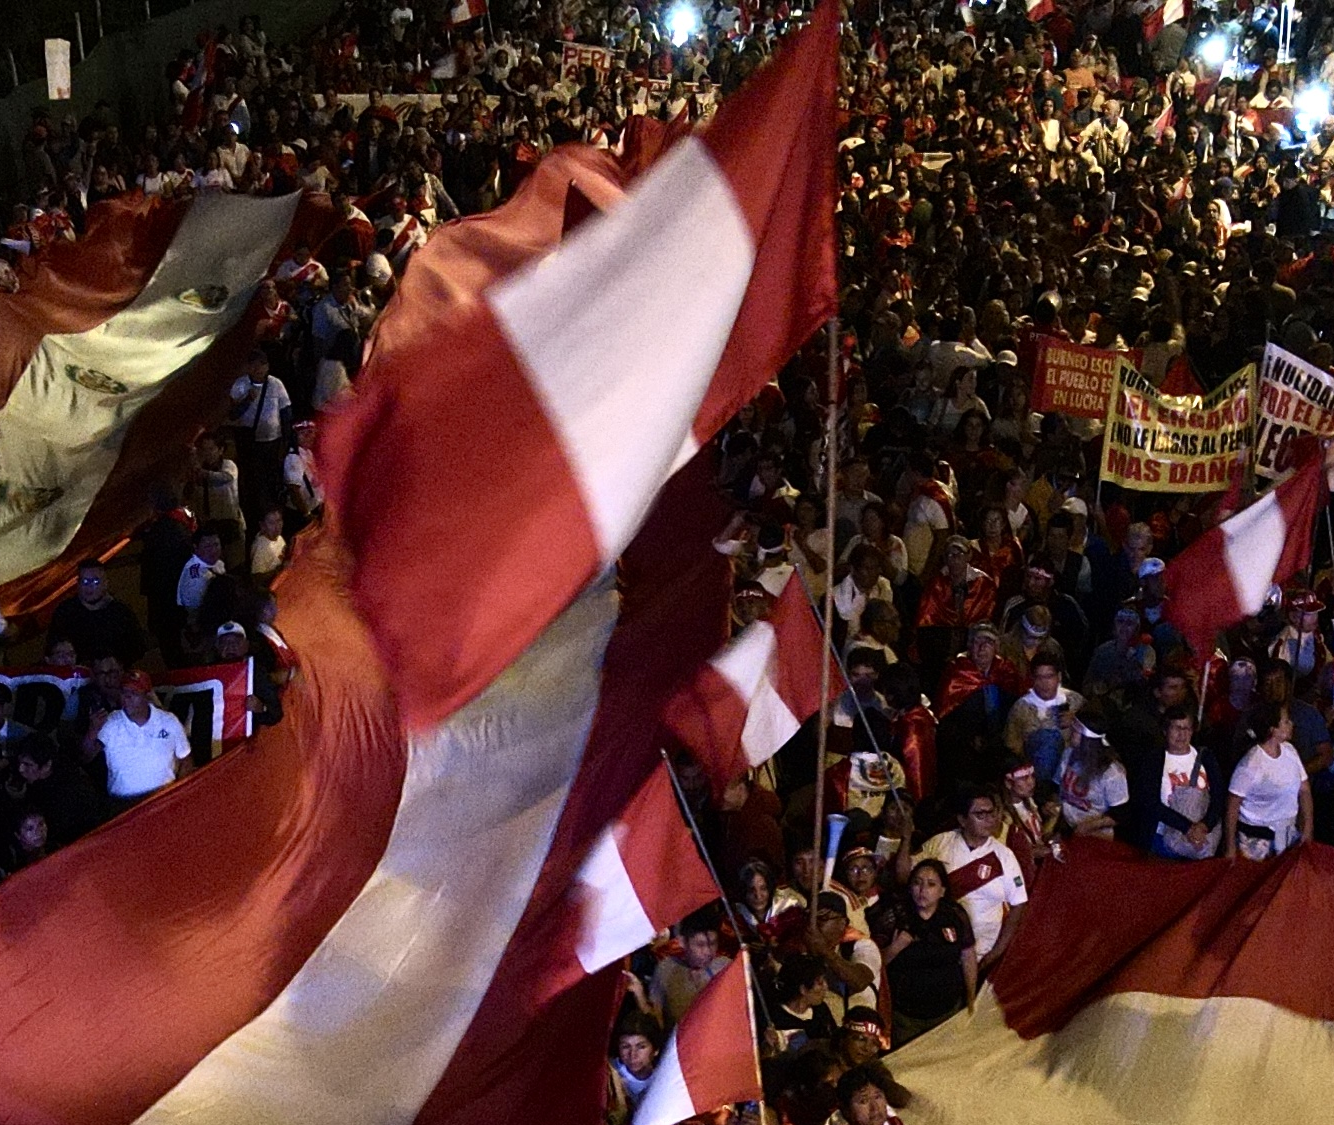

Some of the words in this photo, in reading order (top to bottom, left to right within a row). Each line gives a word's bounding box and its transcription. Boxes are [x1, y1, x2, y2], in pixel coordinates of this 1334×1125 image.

[1047, 347, 1088, 369] BURNEO
[1046, 368, 1057, 387] EL
[1059, 371, 1099, 391] PUEBLO
[1100, 379, 1114, 395] ES
[1052, 391, 1068, 407] EN
[1070, 393, 1105, 411] LUCHA
[1259, 381, 1291, 419] POR
[1292, 400, 1315, 426] EL
[1200, 434, 1216, 453] AL
[1107, 447, 1161, 482] MAS
